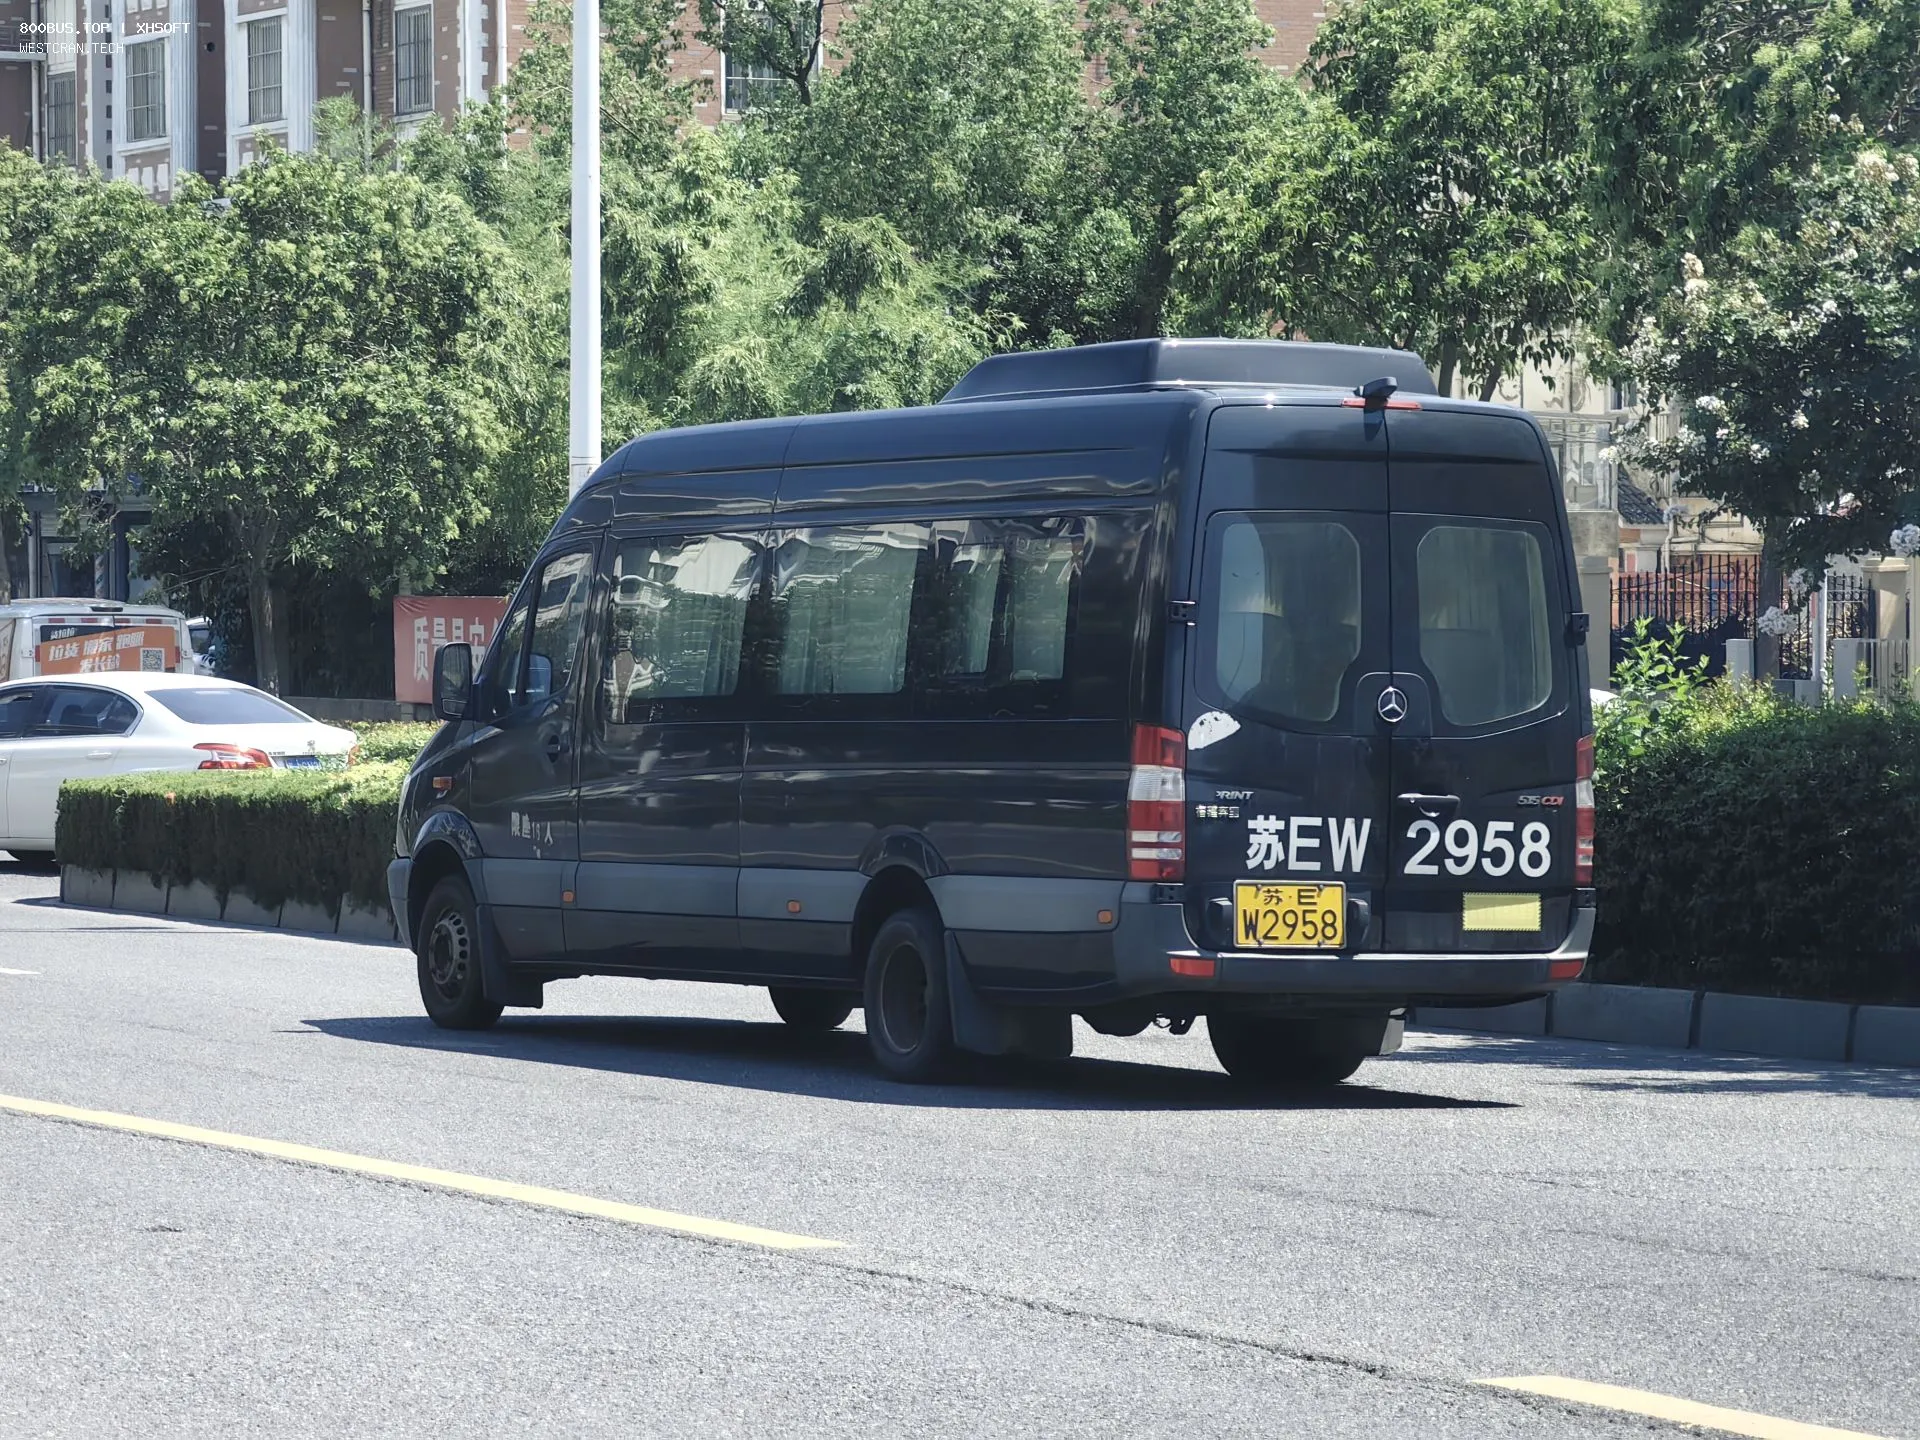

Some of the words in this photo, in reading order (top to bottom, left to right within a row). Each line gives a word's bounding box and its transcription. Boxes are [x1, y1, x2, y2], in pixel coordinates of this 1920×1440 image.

[1245, 814, 1372, 873] 苏EW
[1403, 819, 1552, 878] 2958
[1242, 908, 1338, 941] W2958
